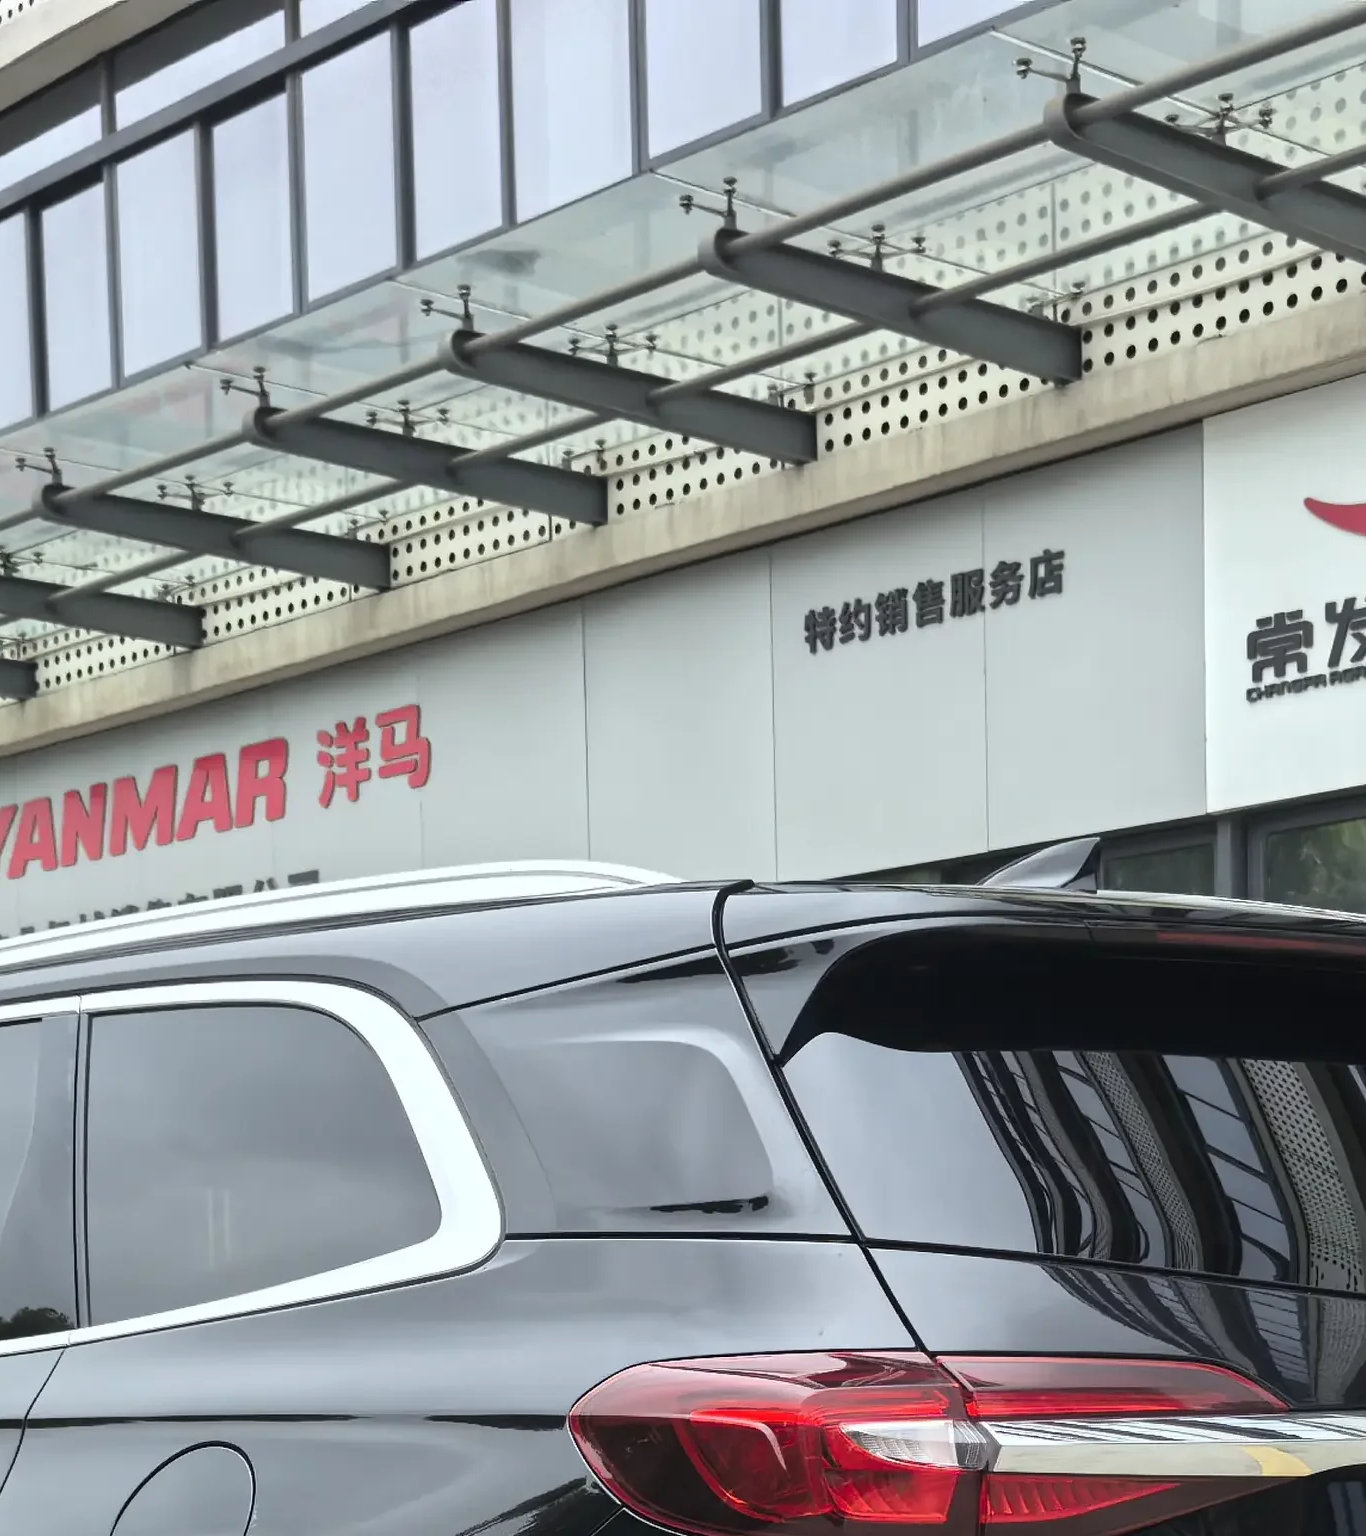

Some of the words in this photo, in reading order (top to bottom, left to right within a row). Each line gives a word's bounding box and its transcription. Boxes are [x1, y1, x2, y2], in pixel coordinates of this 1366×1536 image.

[803, 548, 1066, 656] 特约销售服务店
[316, 703, 432, 809] 洋马
